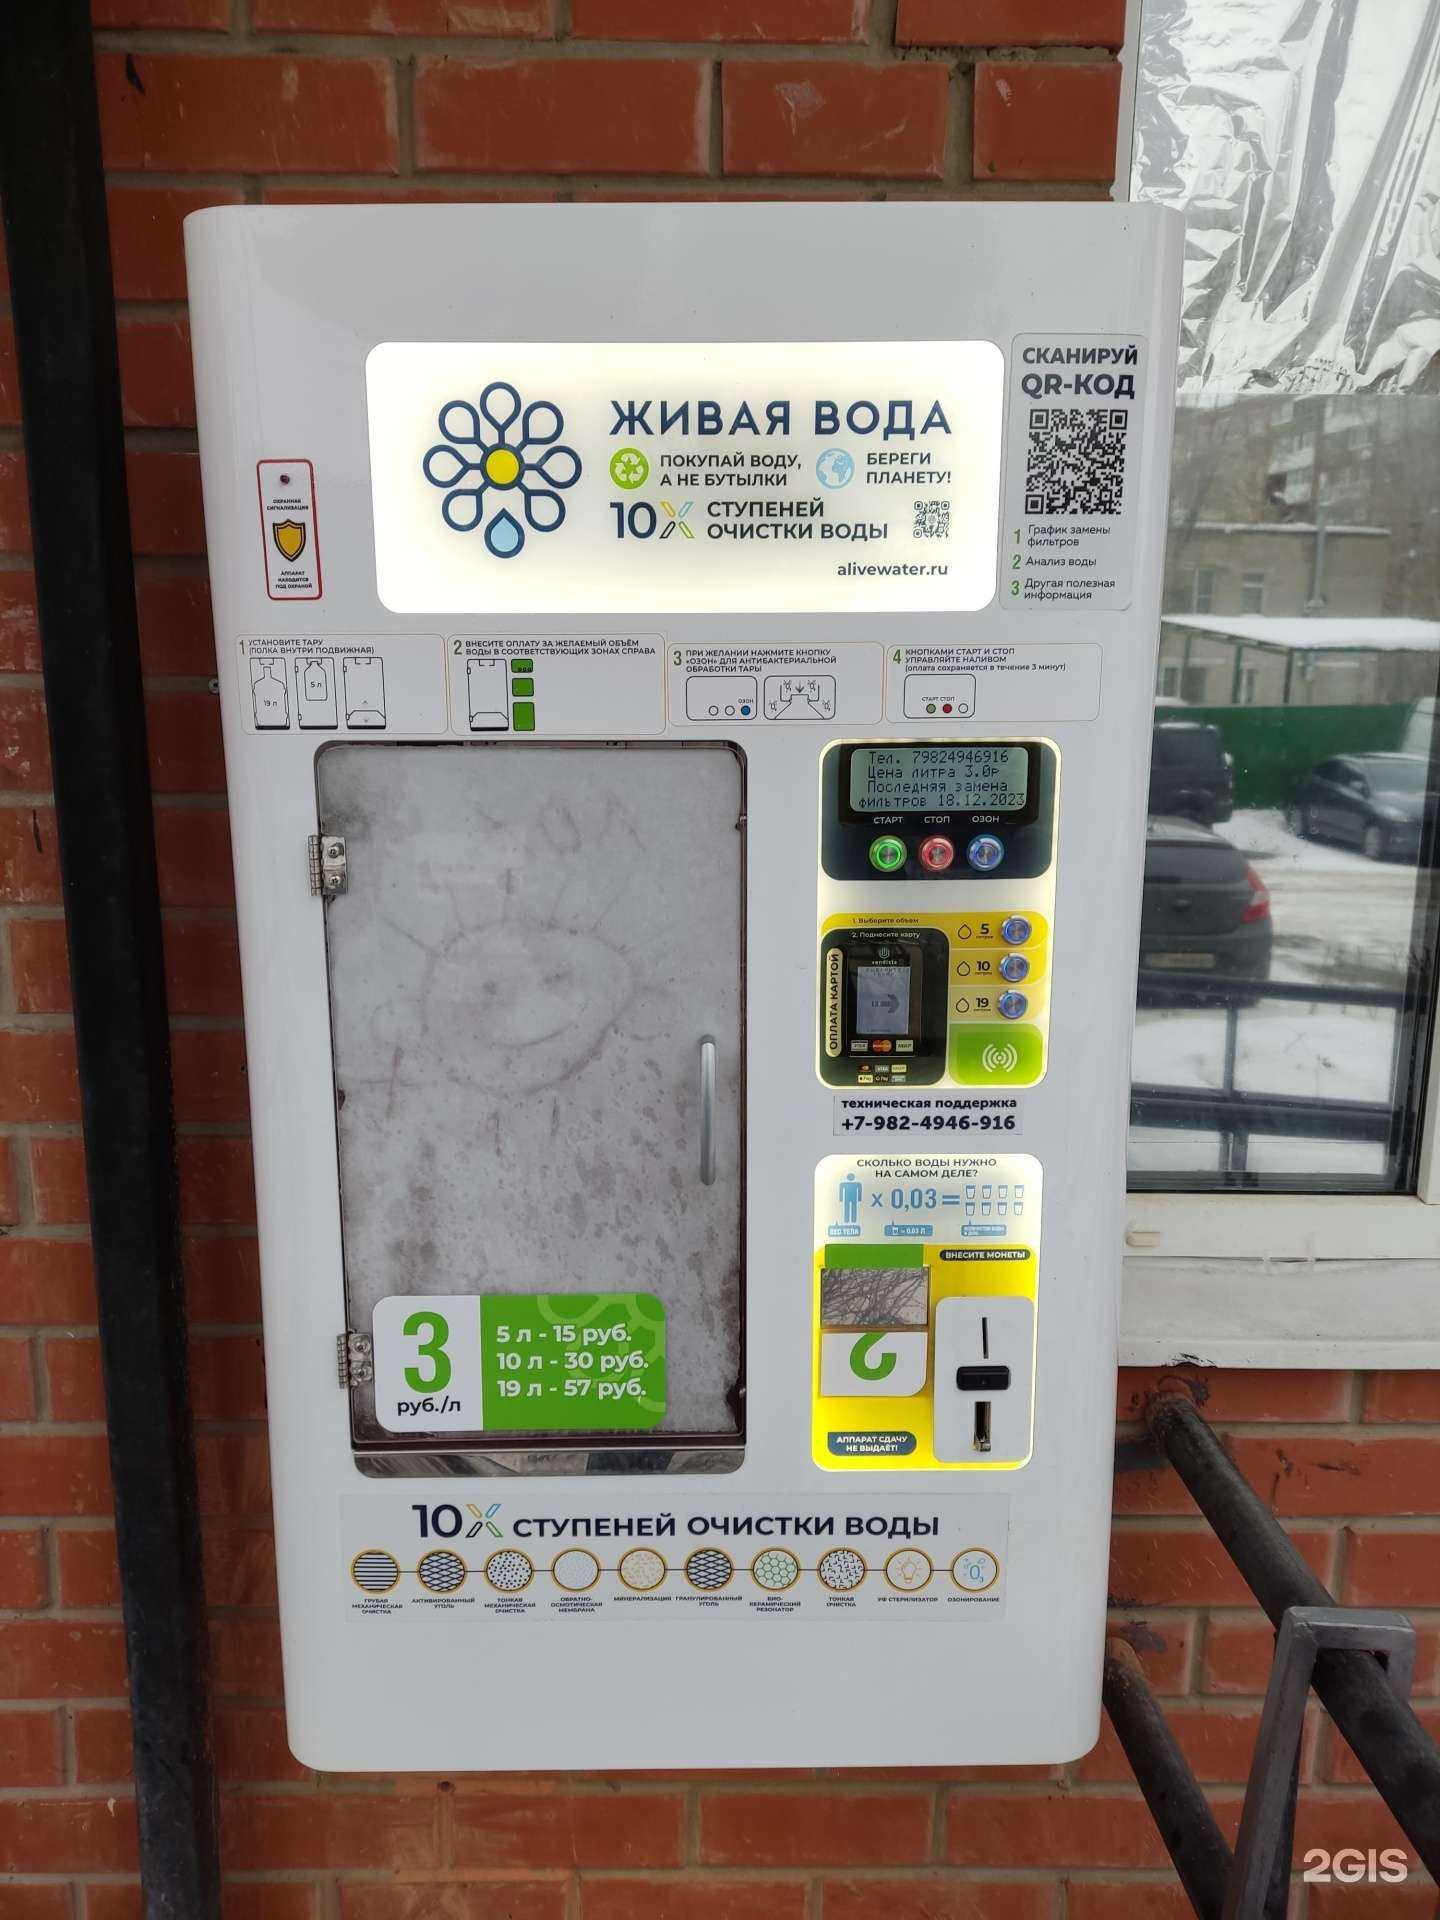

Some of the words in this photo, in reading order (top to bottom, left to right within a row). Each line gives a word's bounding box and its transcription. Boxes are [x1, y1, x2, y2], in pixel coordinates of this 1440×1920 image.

[1022, 345, 1138, 365] СКАНИРУЙ
[1021, 373, 1135, 400] QR-КОД
[609, 400, 791, 436] ЖИВАЯ
[815, 400, 952, 441] ВОДА
[660, 451, 745, 468] ПОКУПАЙ
[750, 455, 802, 470] ВОДУ,
[867, 452, 931, 465] БЕРЕГИ
[660, 474, 672, 486] А
[677, 474, 699, 486] НЕ
[704, 474, 787, 486] БУТЫЛКИ
[866, 471, 952, 485] ПЛАНЕТУ!
[707, 497, 825, 518] СТУПЕНЕЙ
[707, 523, 813, 540] ОЧИСТКИ
[820, 523, 888, 542] ВОДЫ
[1013, 528, 1021, 544] 1
[1027, 524, 1068, 535] График
[1071, 525, 1111, 535] замены
[1027, 537, 1080, 547] фильтров
[1012, 554, 1021, 569] 2
[1025, 557, 1065, 567] Анализ
[1068, 557, 1097, 567] воды
[837, 563, 948, 576] alivewater.ru
[1011, 580, 1020, 596] 3
[1024, 578, 1064, 589] Другая
[1066, 579, 1115, 589] полезная
[1024, 590, 1092, 600] информация
[240, 640, 244, 654] 1
[453, 640, 463, 655] 2
[555, 639, 606, 647] ЖЕЛАЕМЫЙ
[609, 639, 639, 647] ОБЪЁМ
[466, 648, 491, 656] ВОДЫ
[501, 648, 589, 656] СООТВЕТСТВУЮЩИХ
[673, 651, 682, 665] 3
[893, 649, 902, 664] 4
[906, 648, 954, 656] КНОПКАМИ
[739, 656, 837, 664] АНТИБАКТЕРИАЛЬНОЙ
[906, 655, 961, 663] УПРАВЛЯЙТЕ
[905, 664, 935, 672] (оплата
[1038, 663, 1066, 671] минут)
[869, 752, 901, 765] Тел.
[912, 750, 1009, 765] 79824946916
[868, 767, 903, 780] Цена
[912, 768, 955, 779] литра
[867, 781, 946, 793] Последняя
[955, 782, 1008, 792] замена
[938, 793, 1025, 807] 18.12.2023
[873, 816, 903, 824] СТАРТ
[924, 816, 950, 824] СТОП
[972, 815, 999, 823] ОЗОН
[980, 924, 989, 934] 5
[977, 961, 990, 971] 10
[829, 954, 839, 999] КАРТОЙ
[976, 998, 989, 1007] 19
[830, 1002, 838, 1050] ОПЛАТА
[841, 1100, 931, 1109] техническая
[935, 1099, 1017, 1110] поддержка
[841, 1115, 1015, 1130] +7-982-4946-916
[857, 1159, 911, 1167] СКОЛЬКО
[915, 1159, 950, 1168] ВОДЫ
[954, 1158, 997, 1166] НУЖНО
[875, 1169, 891, 1178] НА
[894, 1169, 938, 1178] САМОМ
[941, 1169, 978, 1178] ДЕЛЕ?
[890, 1189, 937, 1211] 0,03
[496, 1326, 510, 1343] 5
[516, 1328, 532, 1343] л
[552, 1325, 576, 1342] 15
[582, 1323, 632, 1346] руб.
[402, 1312, 452, 1394] 3
[496, 1352, 522, 1370] 10
[527, 1354, 543, 1370] л
[564, 1352, 594, 1370] 30
[600, 1350, 649, 1372] руб.
[496, 1380, 521, 1398] 19
[526, 1381, 542, 1397] л
[564, 1379, 592, 1397] 57
[598, 1378, 646, 1400] руб.
[396, 1396, 462, 1416] руб./л
[836, 1436, 878, 1444] АППАРАТ
[879, 1436, 908, 1444] СДАЧУ
[846, 1444, 858, 1452] НЕ
[859, 1443, 898, 1452] ВЫДАЁТ!
[513, 1512, 676, 1537] СТУПЕНЕЙ
[687, 1516, 834, 1536] ОЧИСТКИ
[846, 1516, 939, 1540] ВОДЫ
